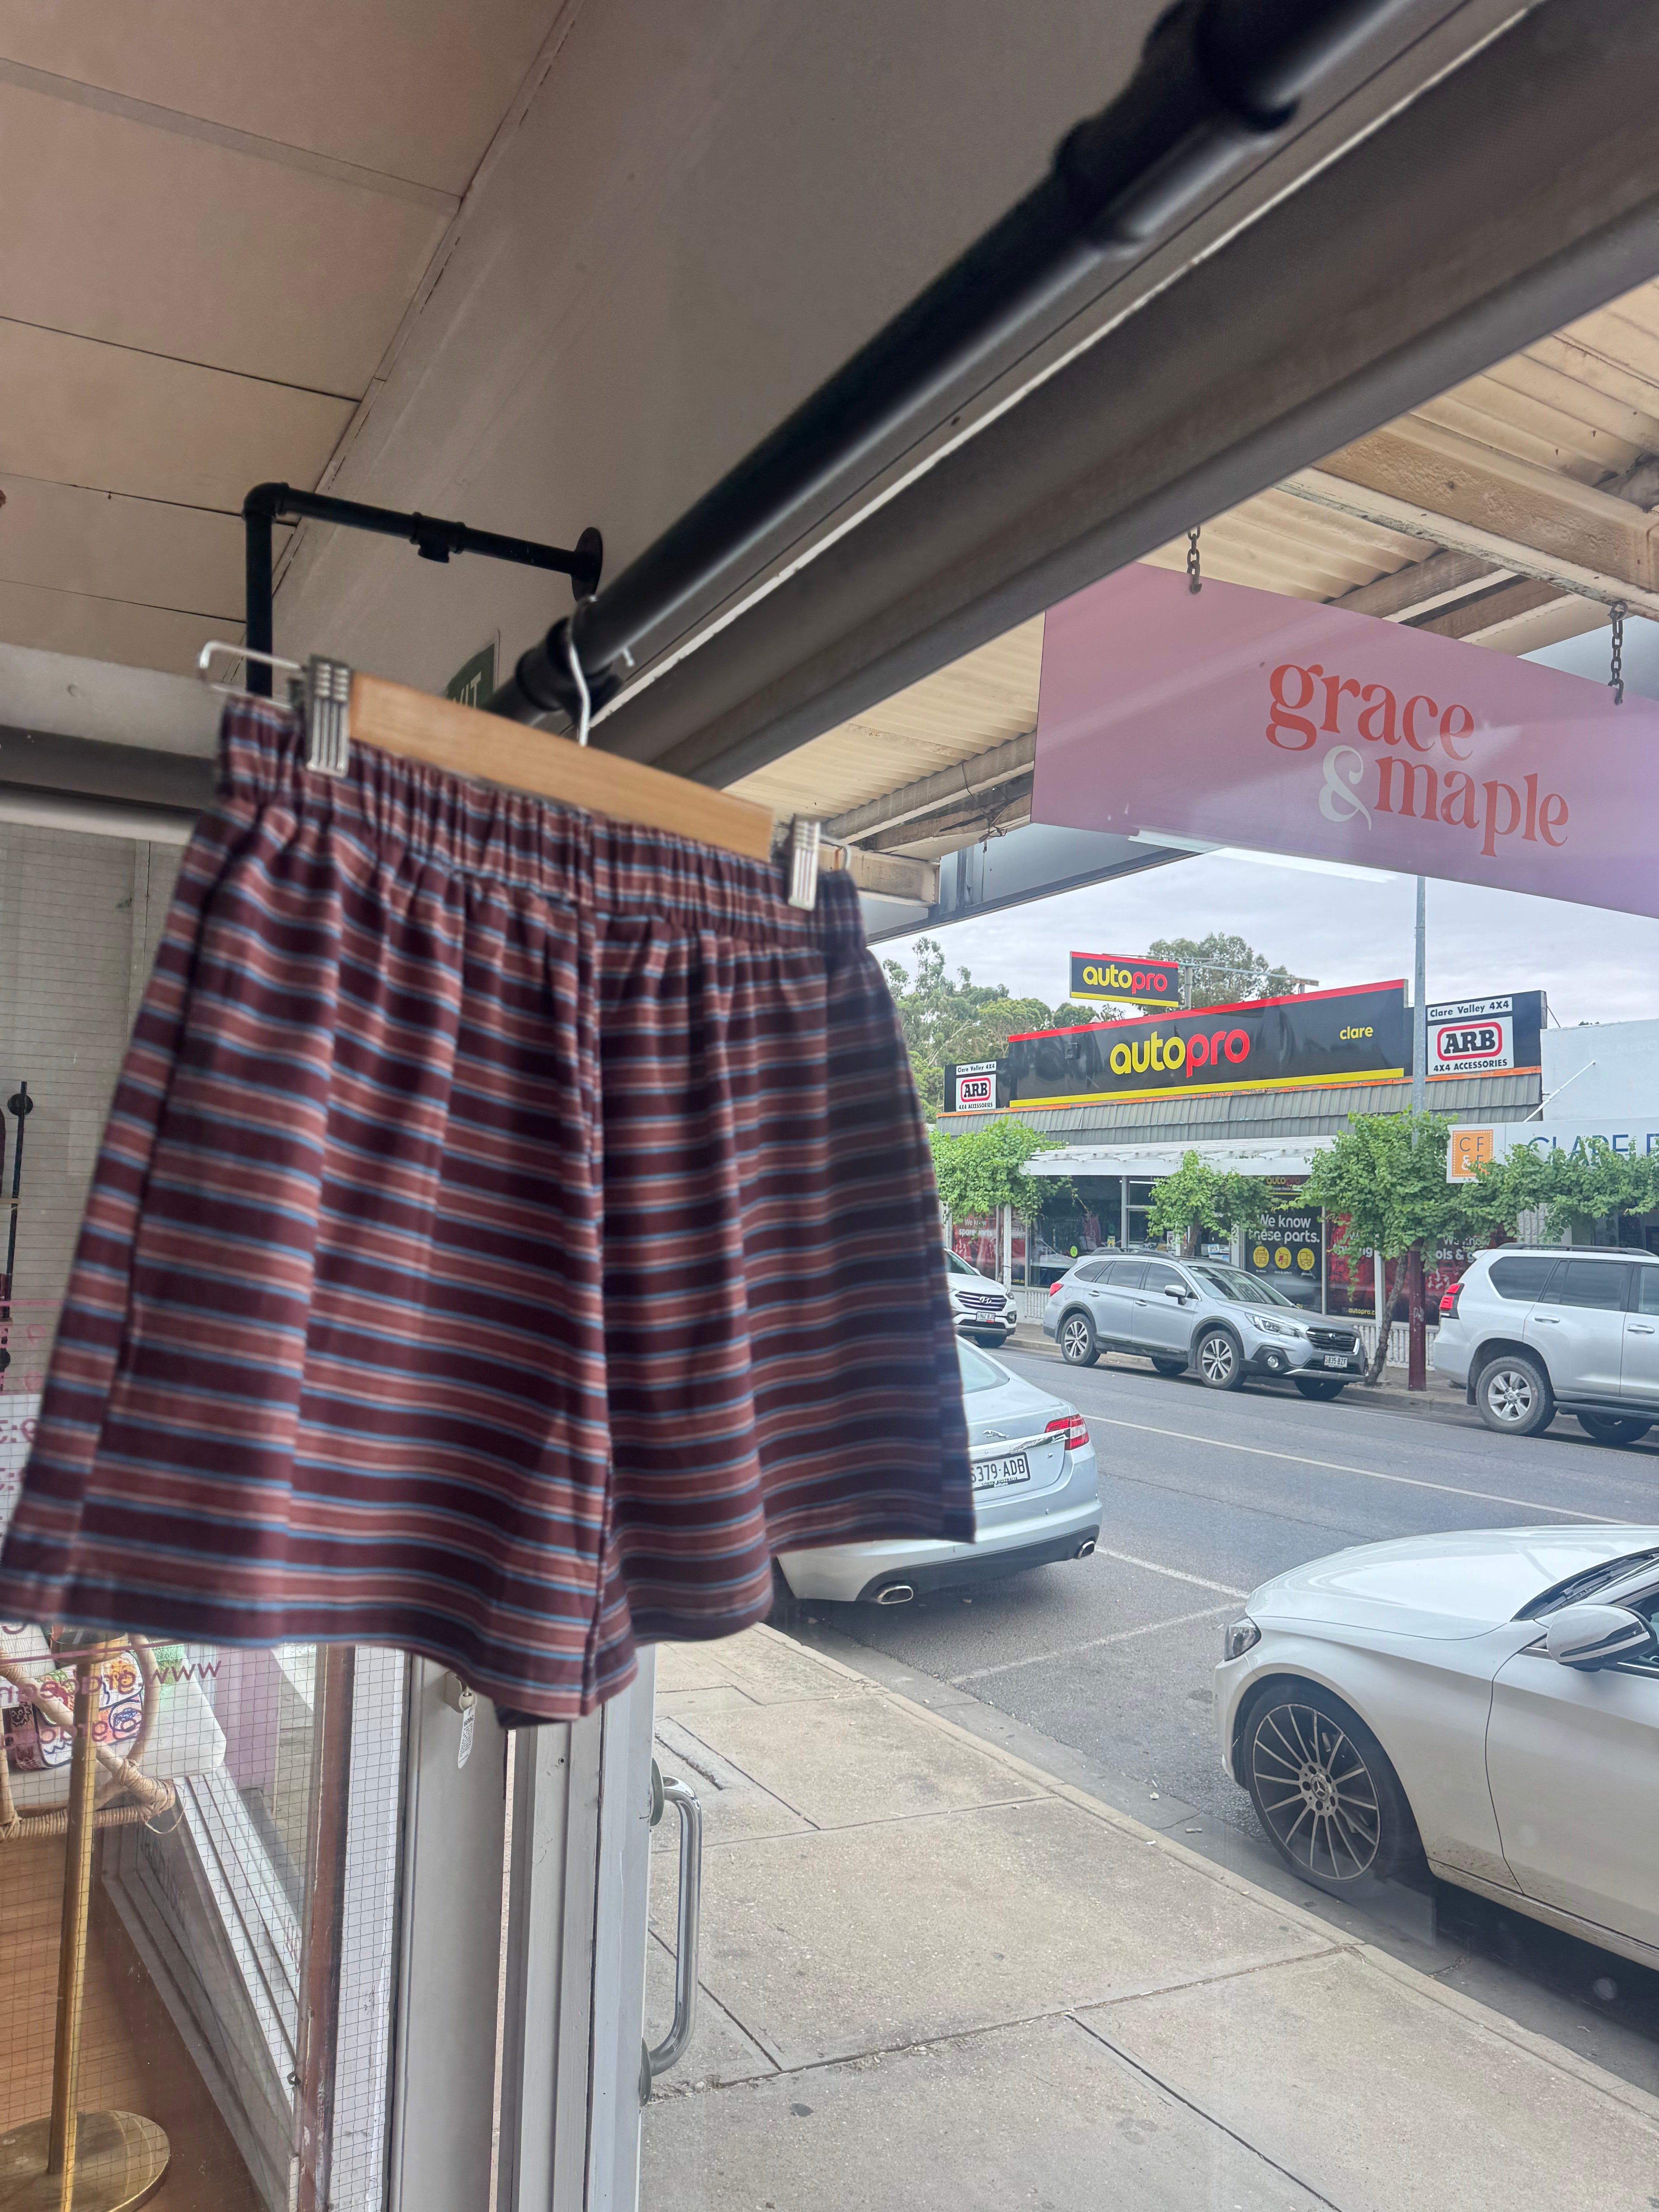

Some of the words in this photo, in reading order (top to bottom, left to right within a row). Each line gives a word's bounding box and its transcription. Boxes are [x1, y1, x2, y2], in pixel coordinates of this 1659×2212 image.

[1266, 663, 1475, 761] grace
[1318, 745, 1372, 831] &
[1374, 756, 1569, 857] maple
[1083, 963, 1168, 994] autopro
[1430, 1009, 1453, 1017] Clare
[1457, 1004, 1485, 1014] Valley
[1489, 1000, 1509, 1010] 4X4
[1340, 1024, 1374, 1041] clare
[1444, 1029, 1495, 1054] ARB
[1110, 1029, 1250, 1078] autopro
[1434, 1064, 1450, 1072] 4X4
[1454, 1059, 1507, 1070] ACCESSORIES
[963, 1082, 988, 1098] ARB
[1278, 1214, 1311, 1228] know
[959, 1228, 976, 1237] spare
[1284, 1230, 1320, 1244] parts.
